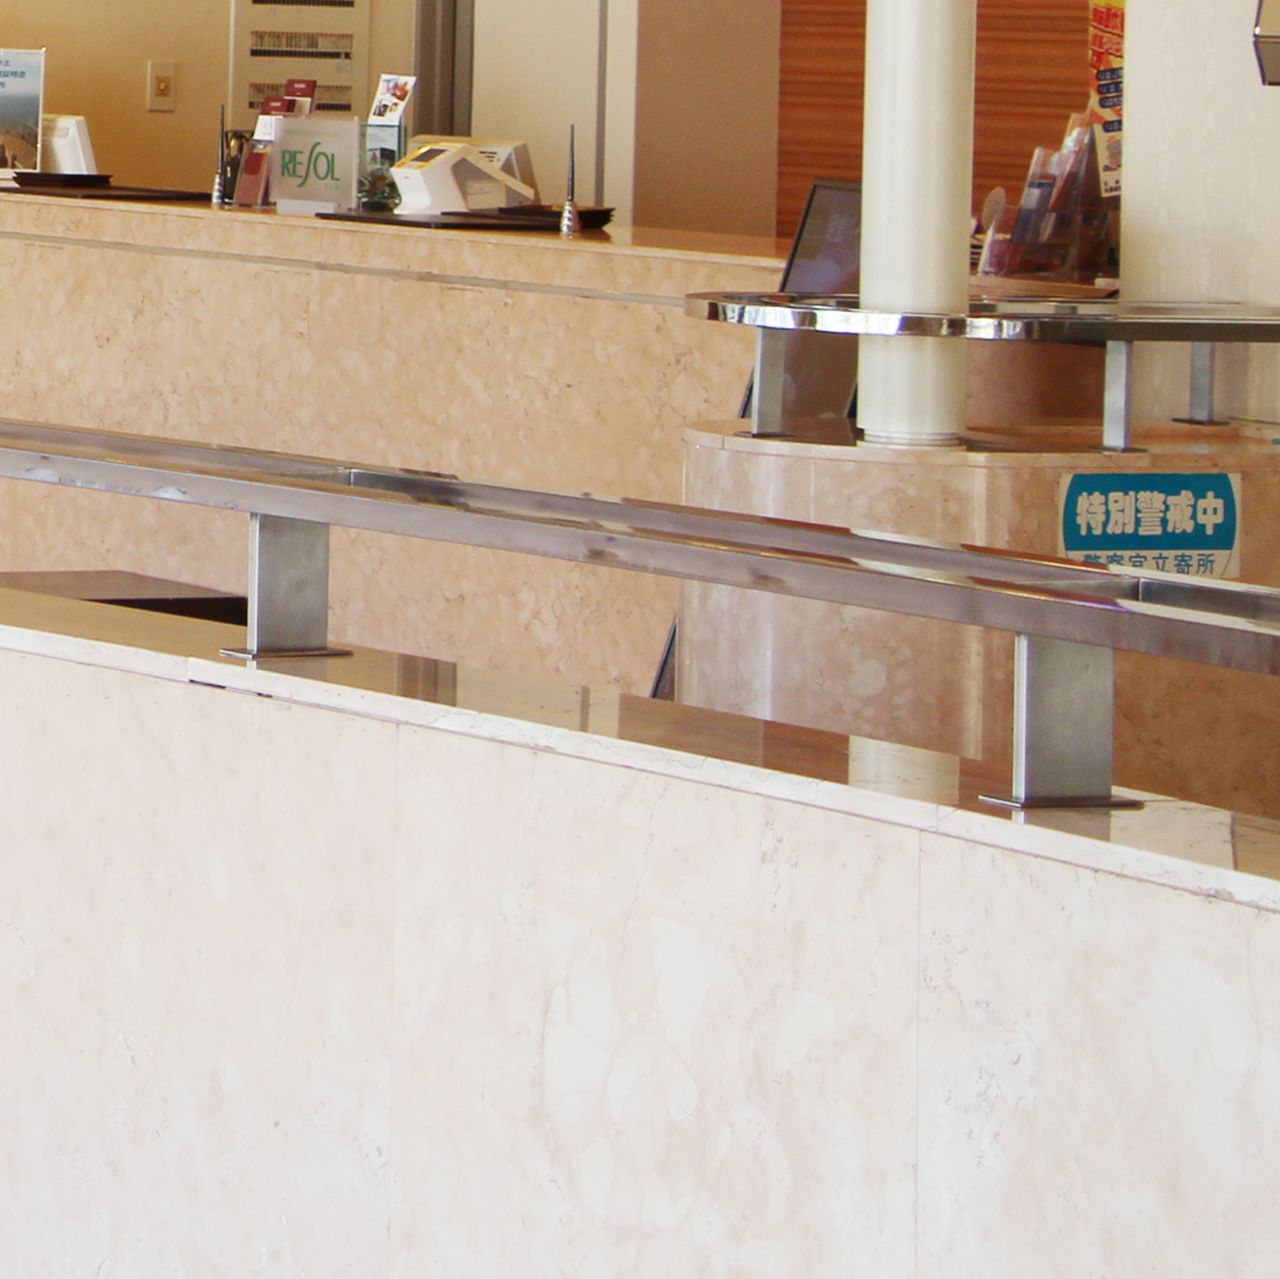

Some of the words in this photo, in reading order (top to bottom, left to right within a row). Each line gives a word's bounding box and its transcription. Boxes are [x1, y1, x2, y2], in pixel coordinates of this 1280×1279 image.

[281, 142, 340, 188] RESOL
[1075, 490, 1225, 536] 特別警戒中
